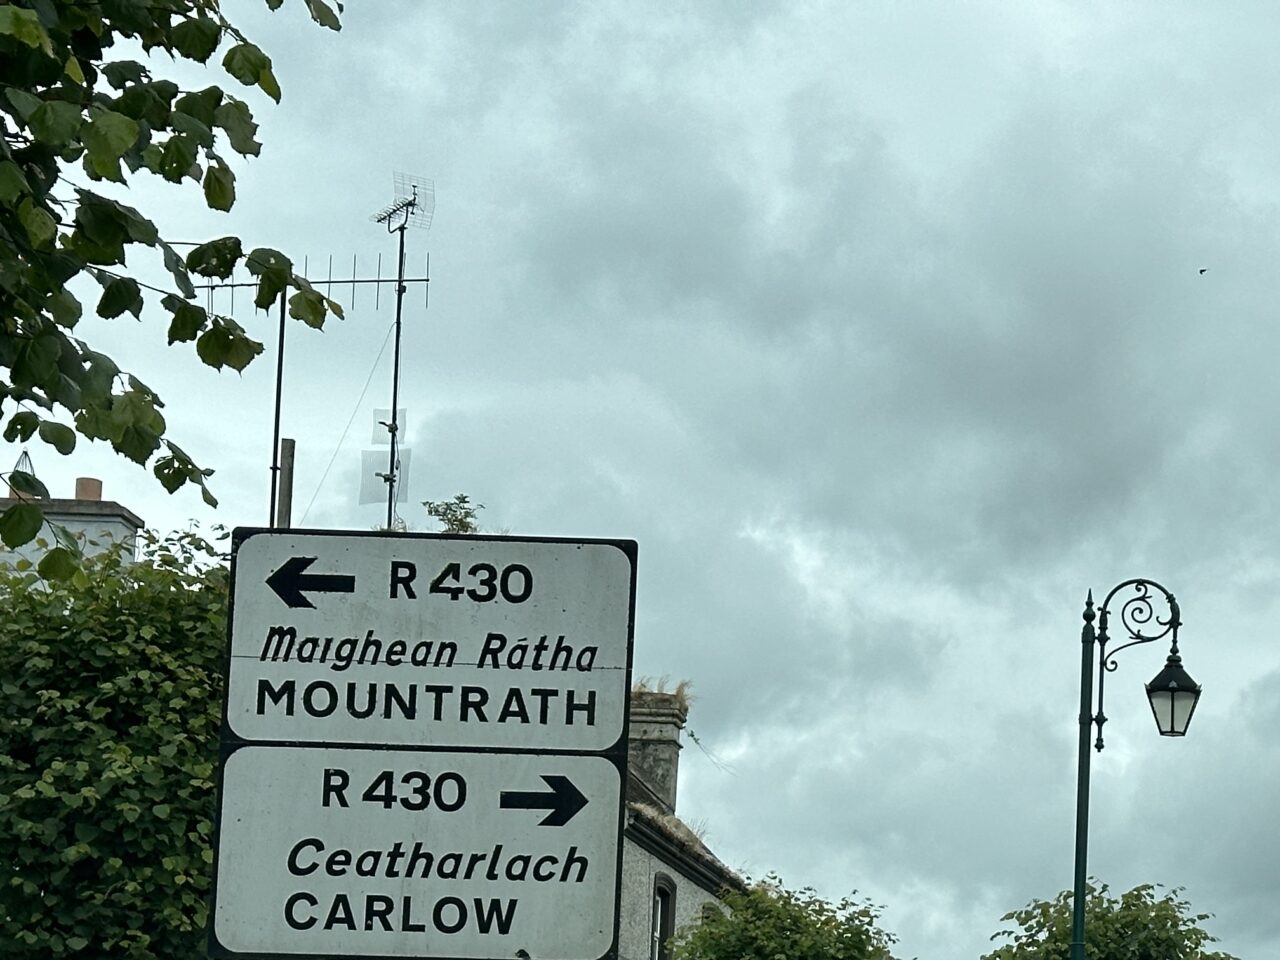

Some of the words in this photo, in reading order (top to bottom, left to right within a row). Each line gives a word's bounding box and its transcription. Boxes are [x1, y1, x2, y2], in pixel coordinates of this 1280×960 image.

[477, 633, 598, 672] Rátha
[256, 679, 596, 726] MOUNTRATH
[287, 838, 589, 883] Ceatharlach
[284, 891, 518, 935] CARLOW
